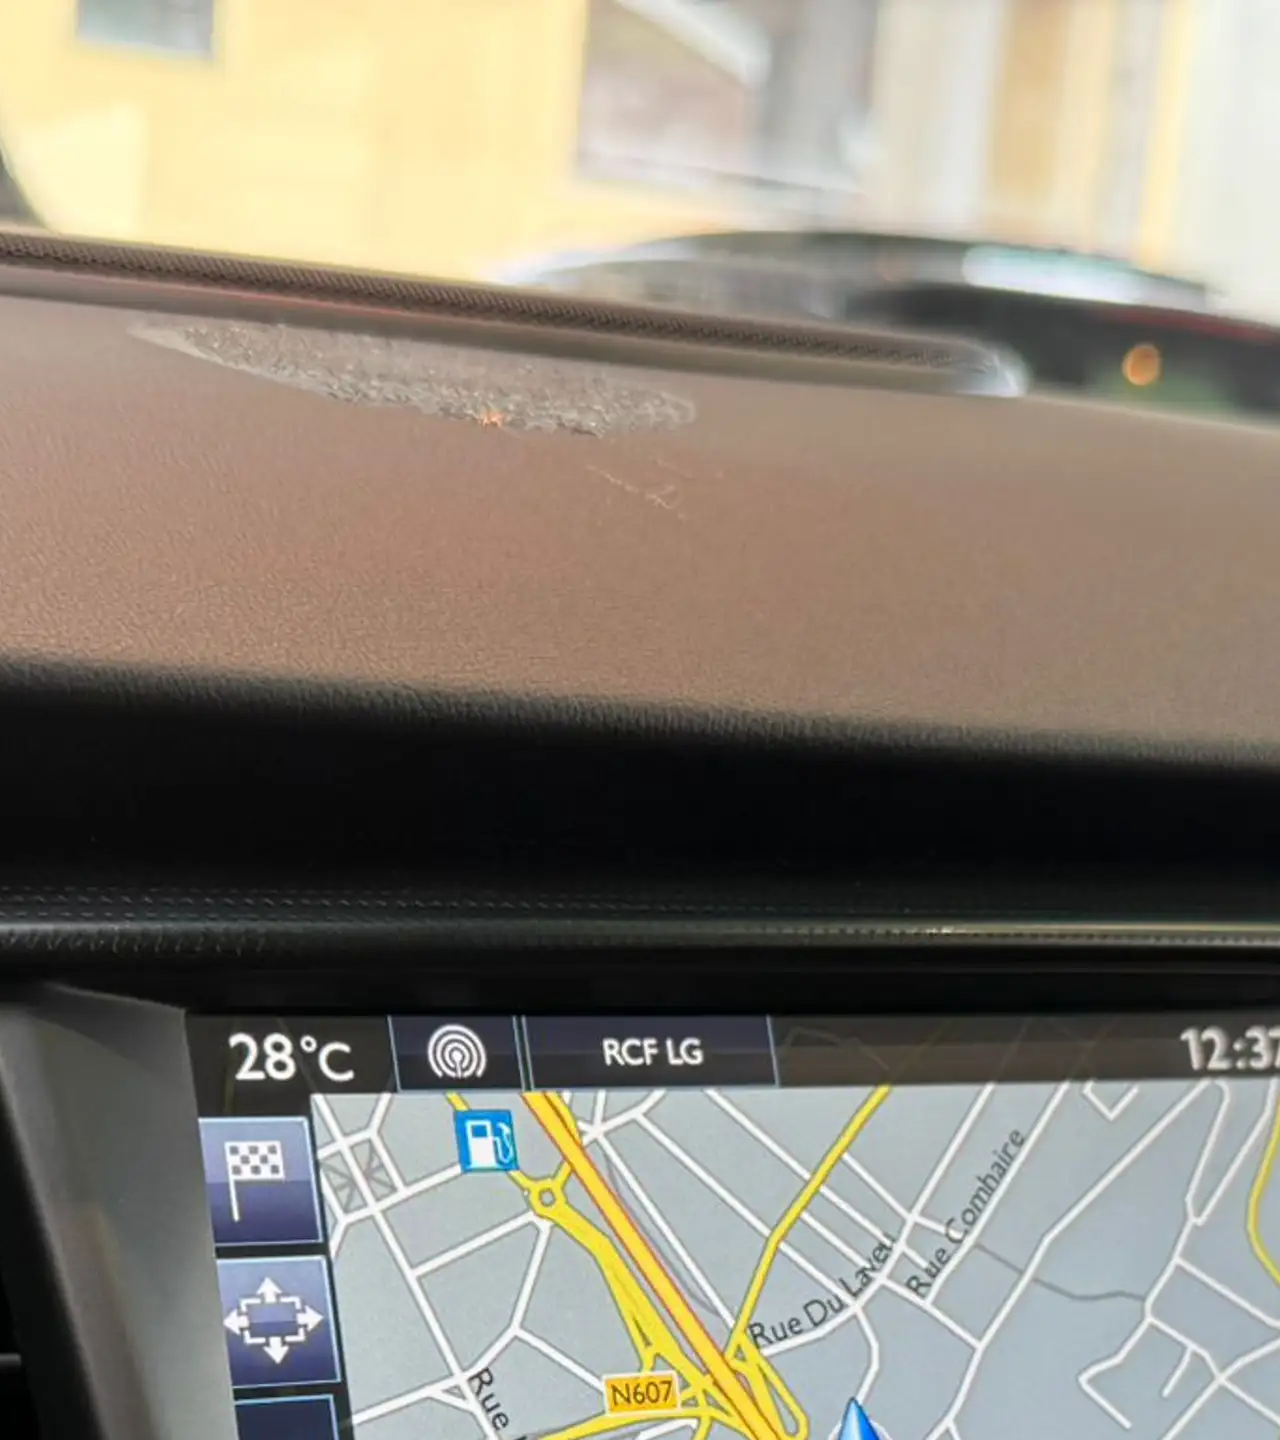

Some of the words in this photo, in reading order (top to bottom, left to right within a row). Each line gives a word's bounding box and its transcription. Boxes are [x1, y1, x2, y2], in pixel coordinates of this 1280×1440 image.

[228, 1031, 355, 1083] 28°C
[602, 1036, 659, 1067] RCF
[665, 1036, 704, 1067] LG
[906, 1246, 951, 1298] Rue
[944, 1129, 1025, 1245] Comhaire
[749, 1317, 803, 1350] Rue
[803, 1295, 845, 1328] Du
[468, 1367, 510, 1431] Rue
[610, 1379, 673, 1407] N607
